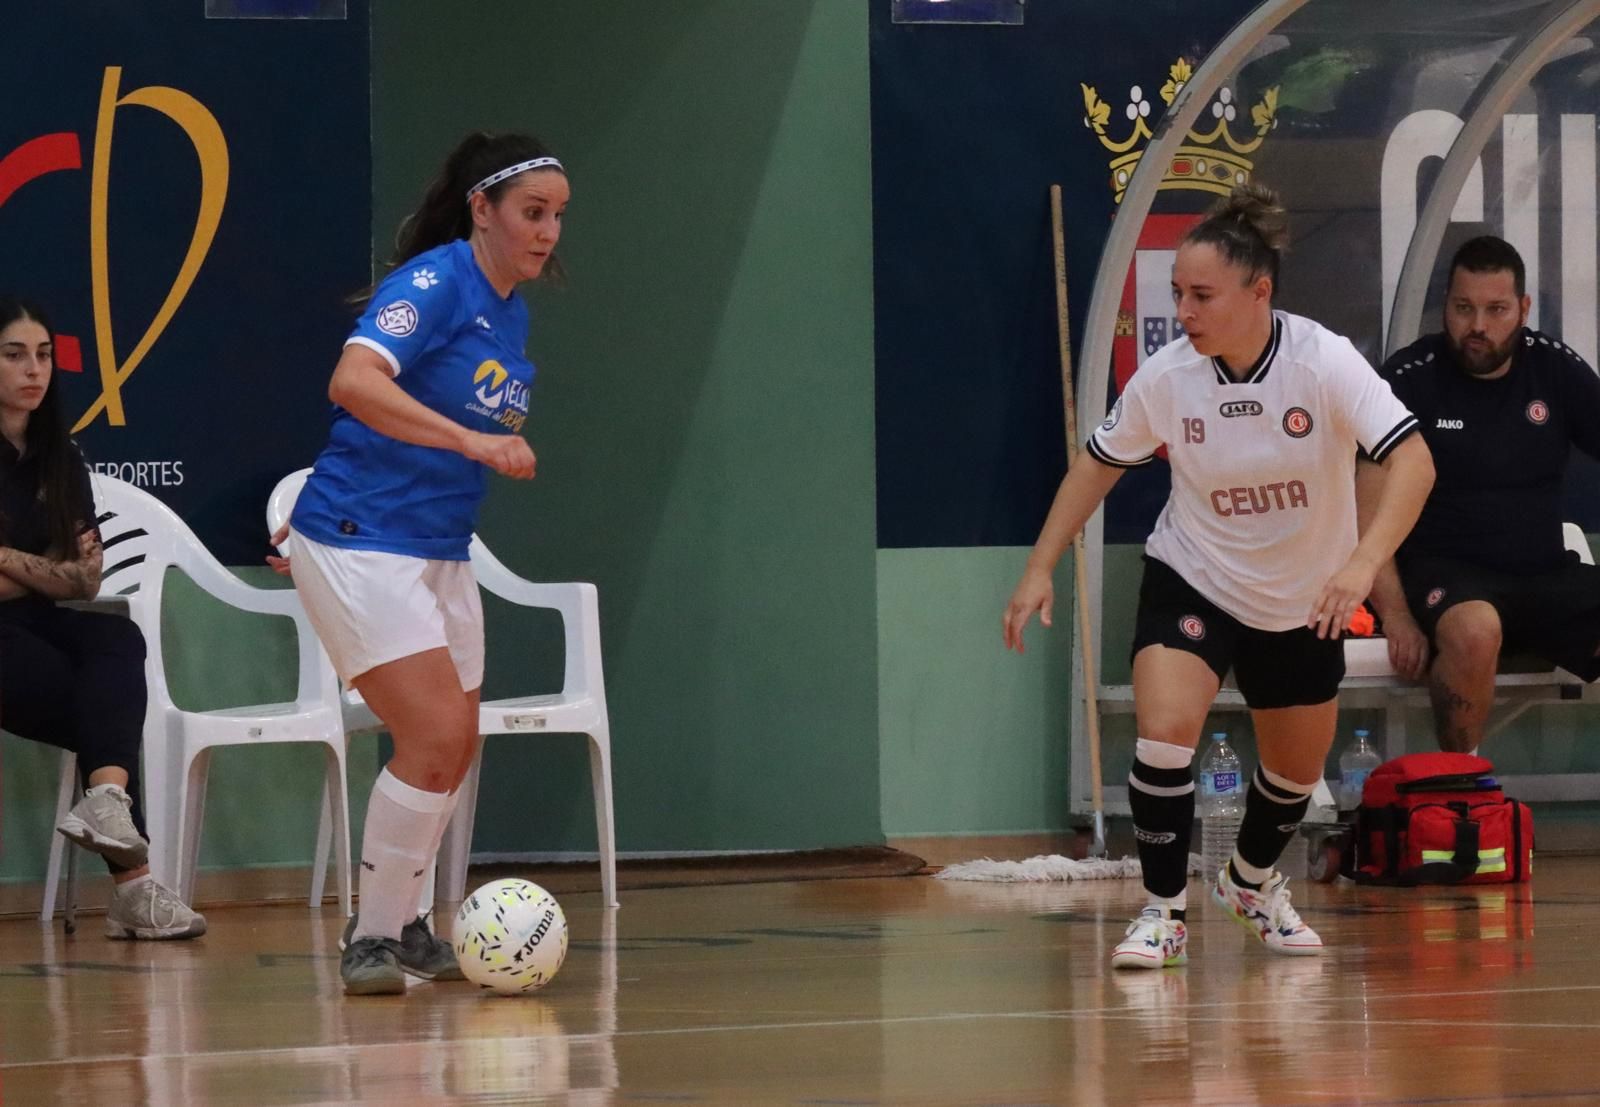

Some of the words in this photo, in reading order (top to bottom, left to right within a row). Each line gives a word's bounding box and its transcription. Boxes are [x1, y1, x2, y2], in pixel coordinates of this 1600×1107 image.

[1182, 417, 1206, 444] 19
[1436, 418, 1464, 430] JAKO
[87, 461, 185, 487] PORTES
[1210, 479, 1309, 517] CEUTA
